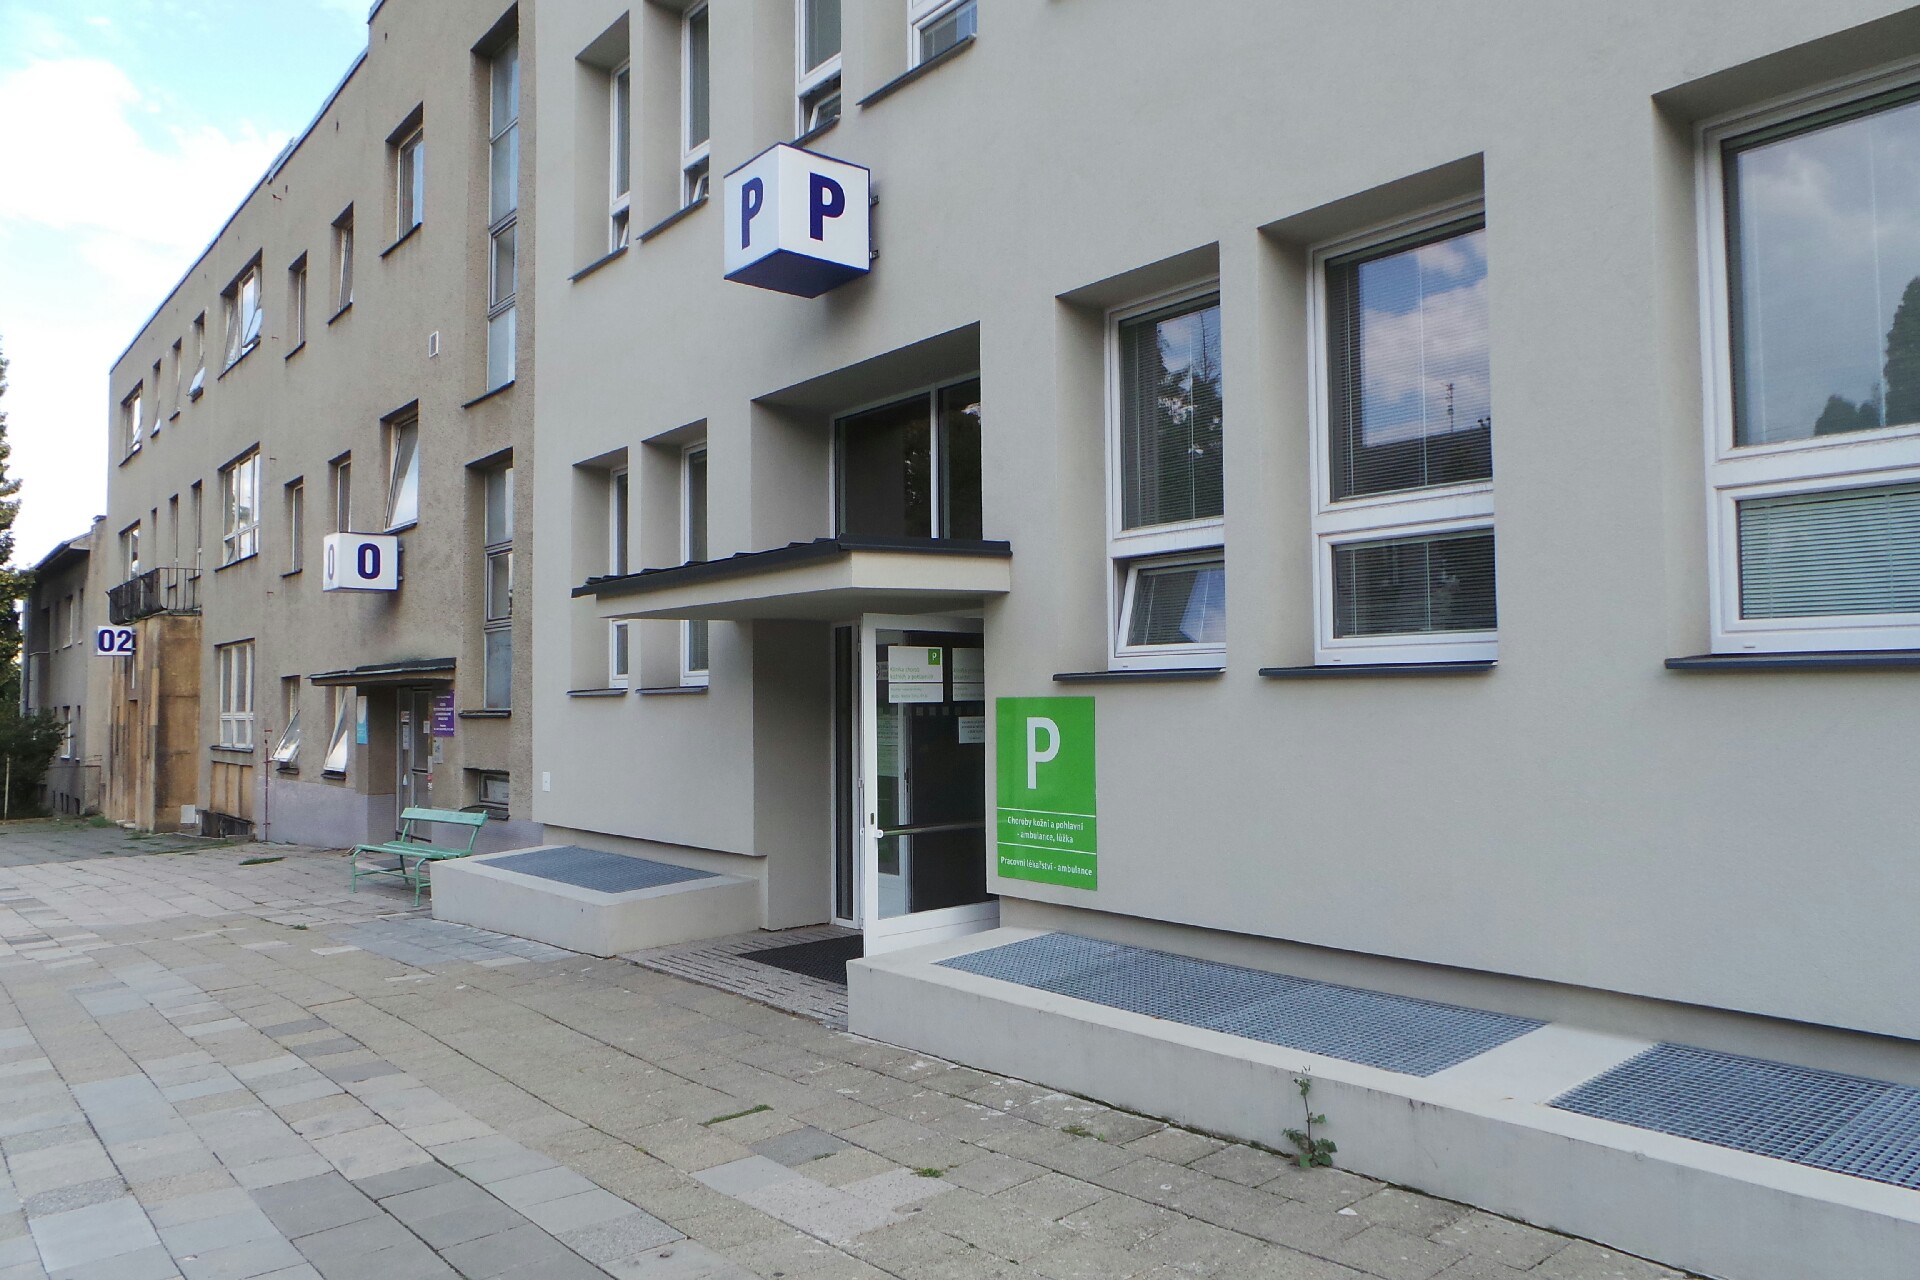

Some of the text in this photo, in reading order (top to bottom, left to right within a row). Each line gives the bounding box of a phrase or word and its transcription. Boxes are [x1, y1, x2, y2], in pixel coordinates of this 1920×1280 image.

[741, 177, 764, 250] P
[809, 172, 846, 242] P
[1026, 716, 1061, 790] P
[1007, 816, 1032, 828] Choroby
[1055, 821, 1084, 831] pohlavní
[1020, 831, 1056, 842] ambulance,
[1000, 856, 1026, 867] Pracovní
[1057, 864, 1093, 876] ambulance
